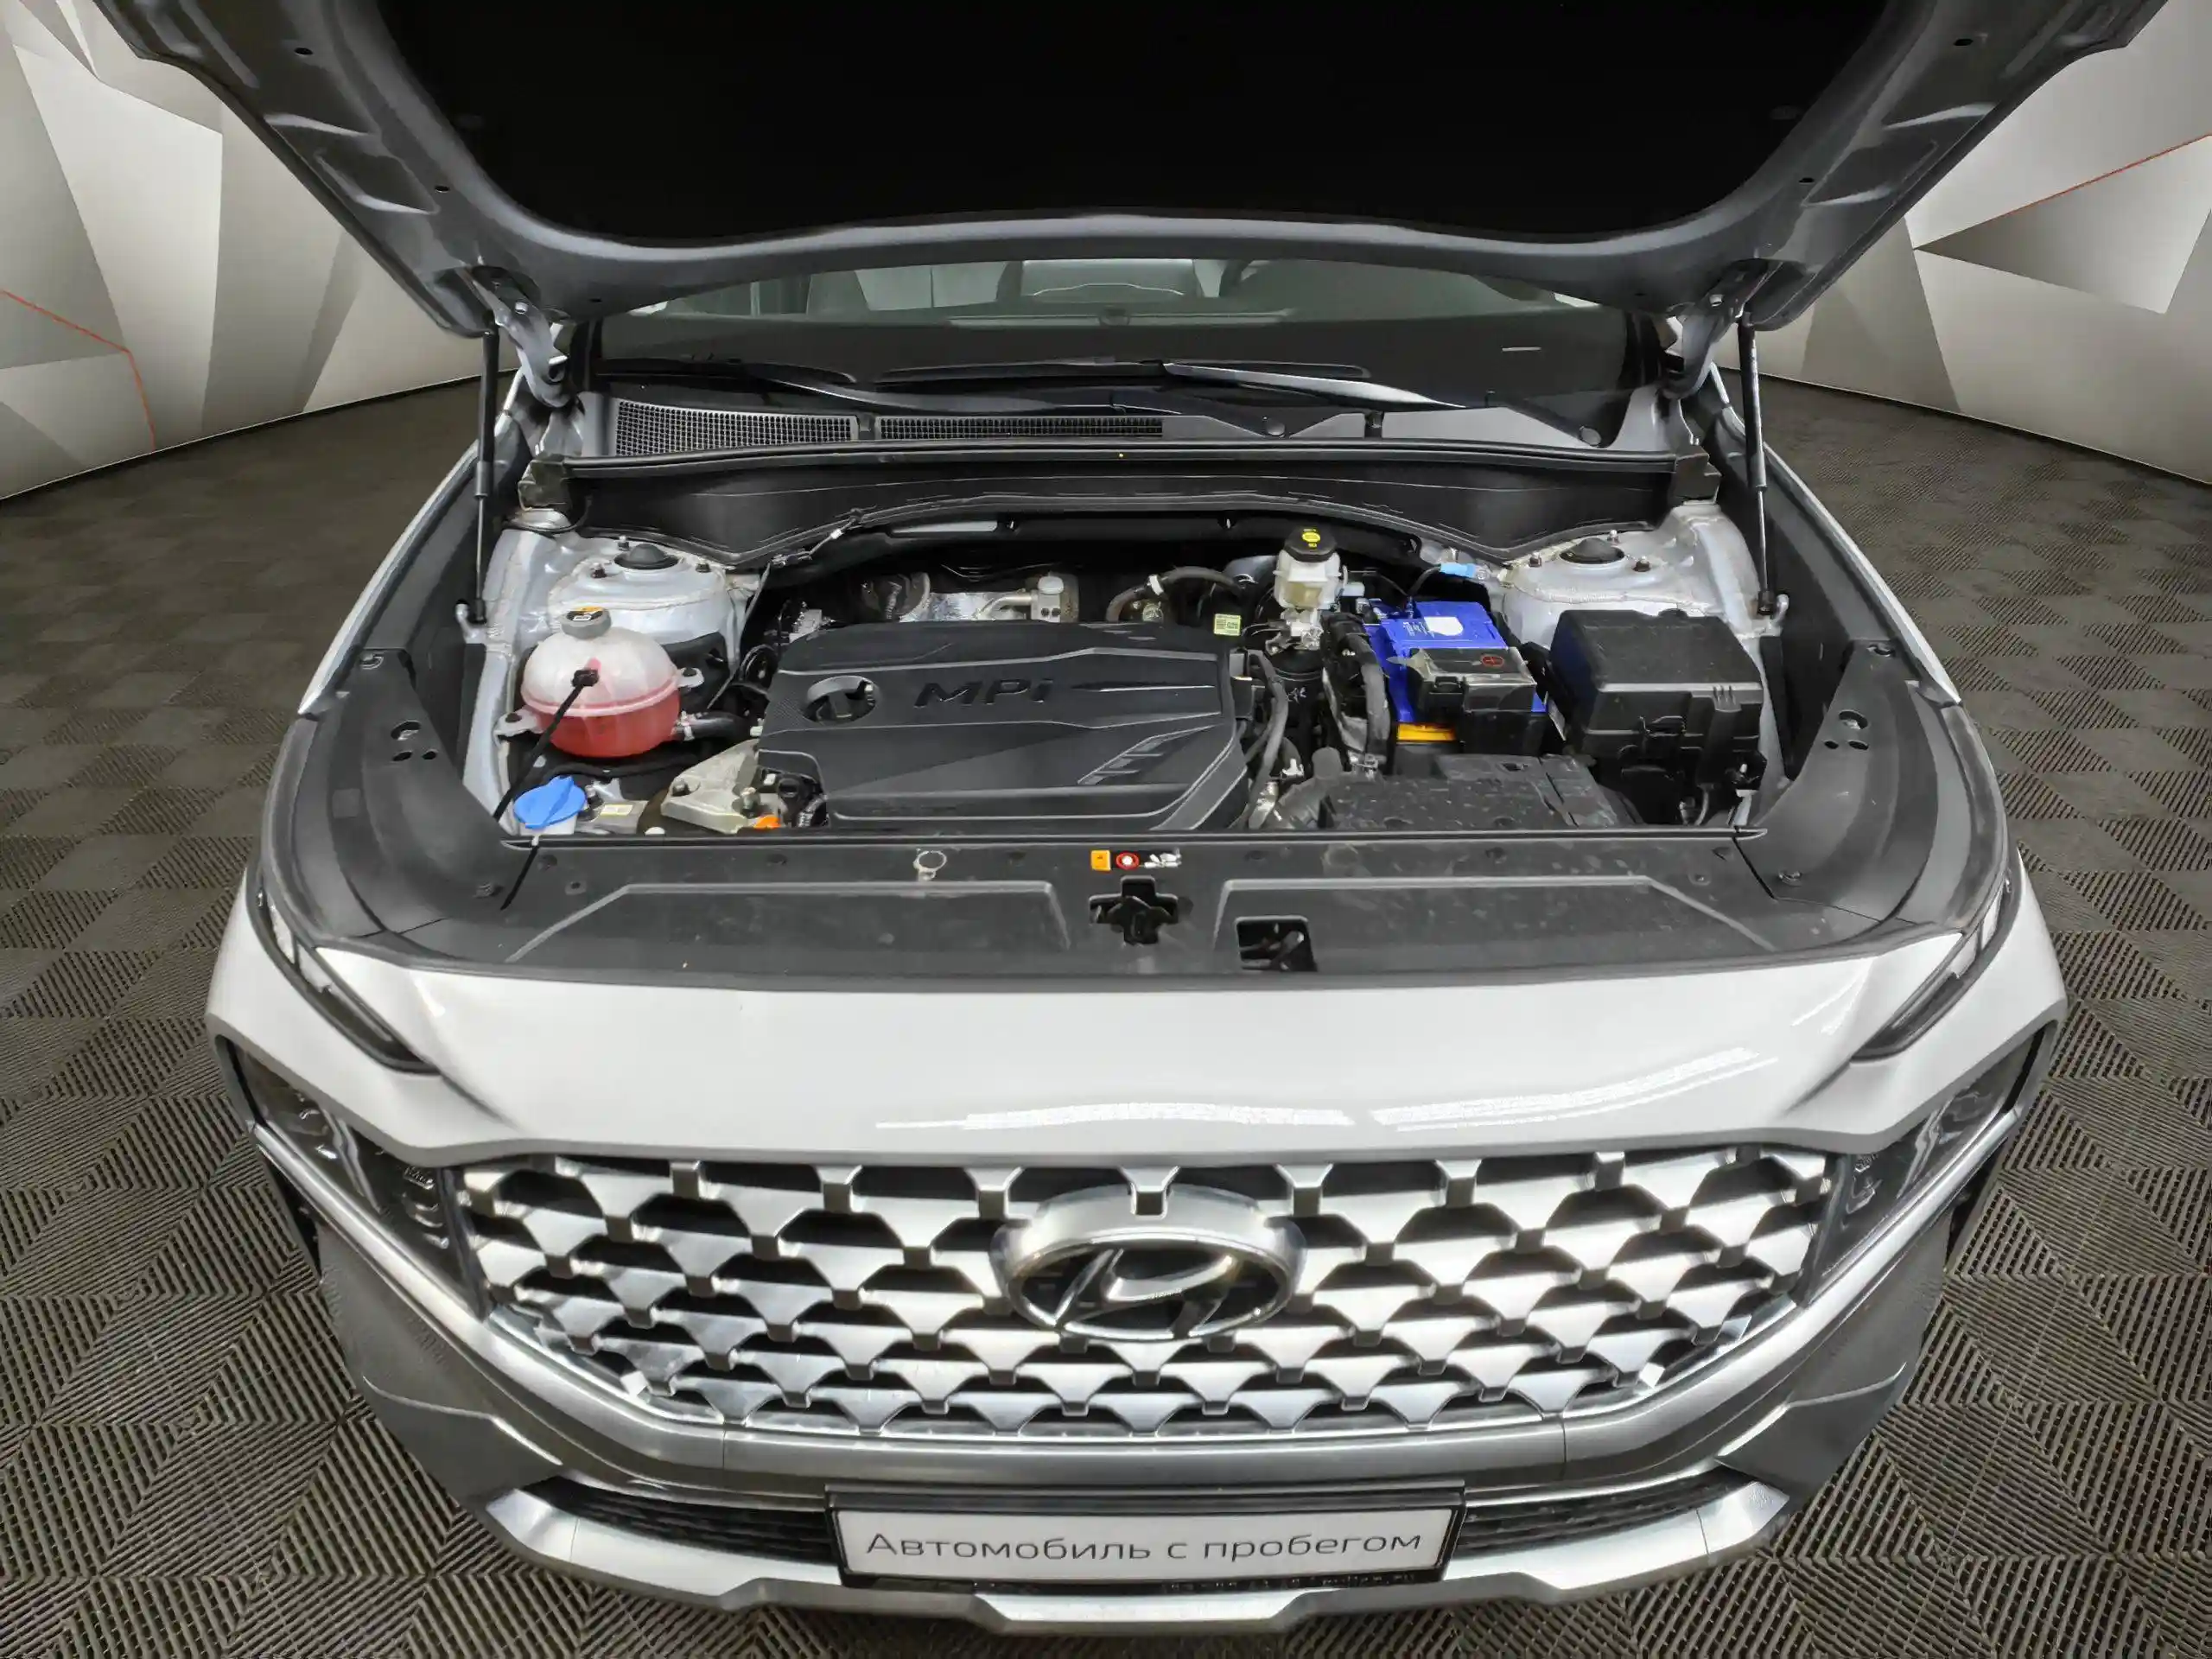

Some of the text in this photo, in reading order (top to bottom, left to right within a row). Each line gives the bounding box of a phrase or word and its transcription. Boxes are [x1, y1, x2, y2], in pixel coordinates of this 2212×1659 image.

[867, 1533, 1421, 1562] Автомобиль с пробегом
